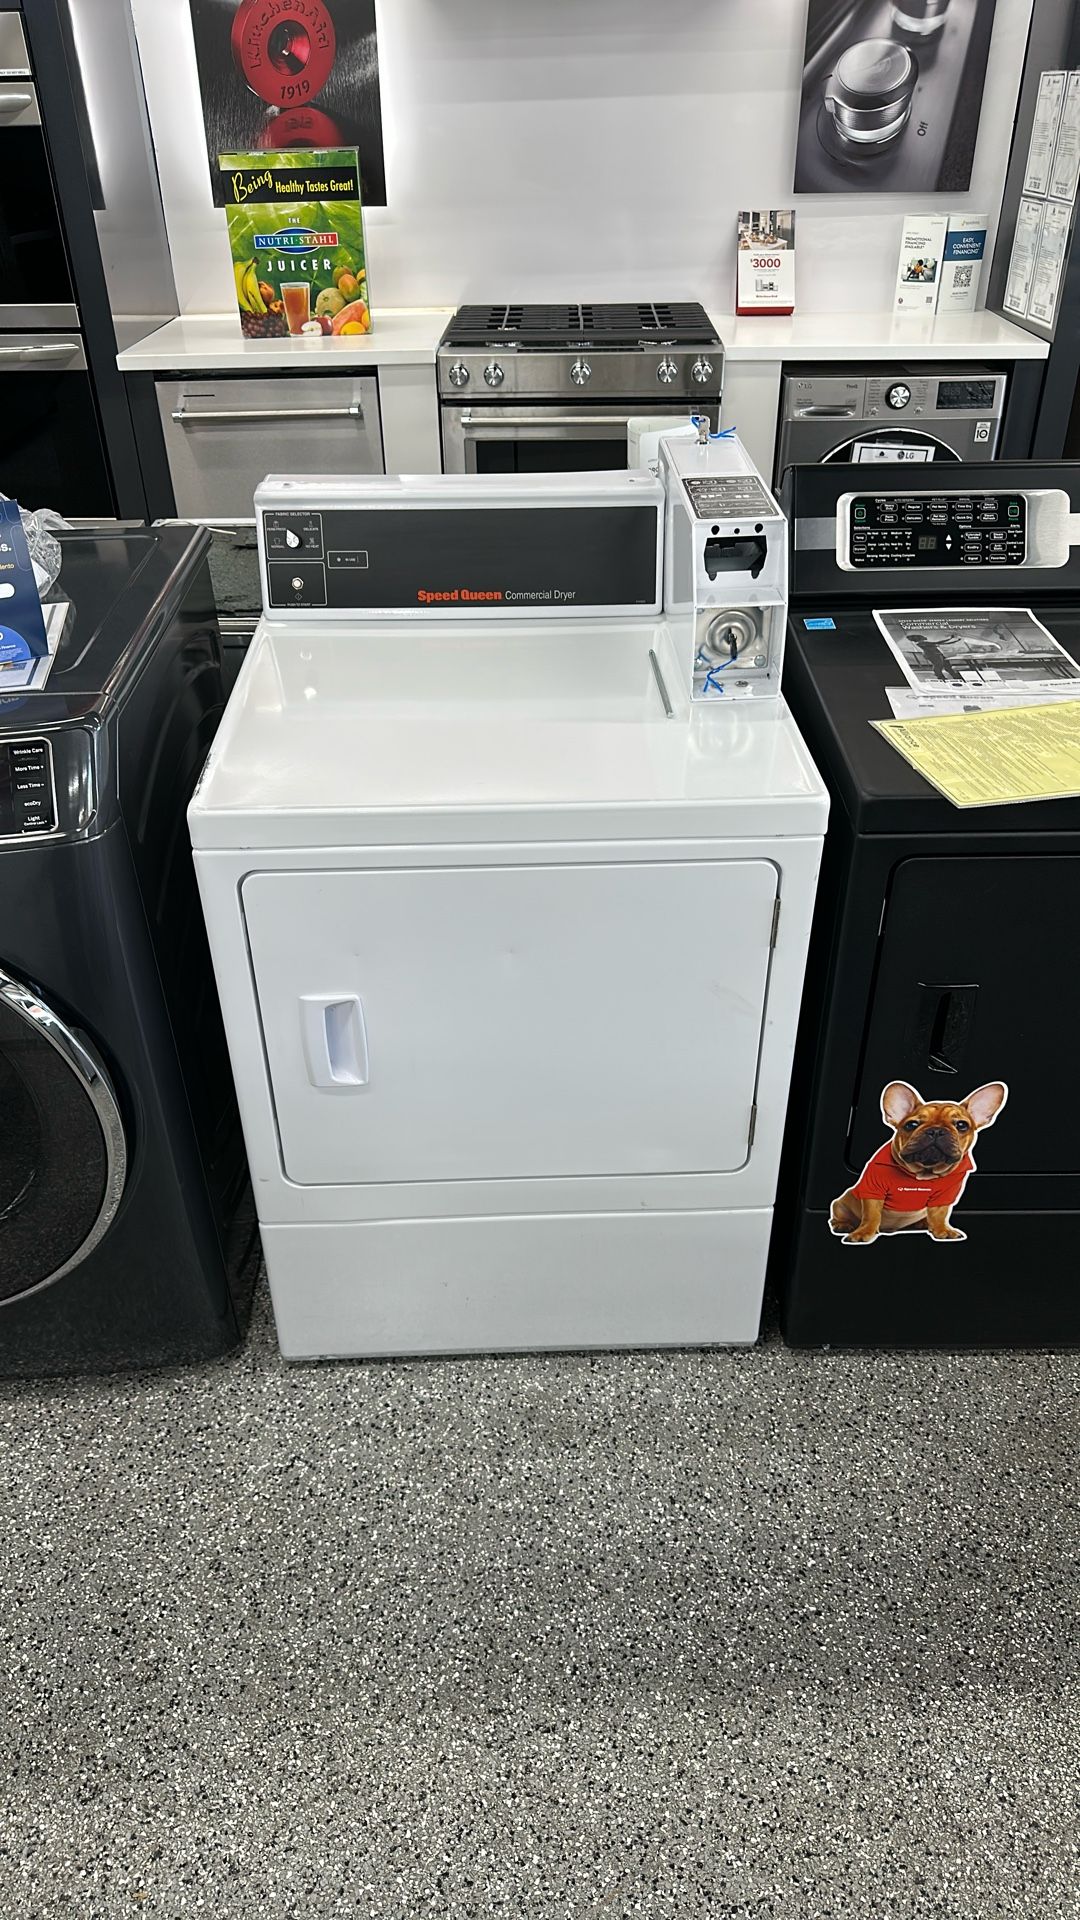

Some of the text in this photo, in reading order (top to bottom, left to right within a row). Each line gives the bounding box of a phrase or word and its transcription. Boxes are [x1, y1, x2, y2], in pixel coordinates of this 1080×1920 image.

[281, 80, 310, 99] 1919
[917, 121, 929, 137] Off
[231, 170, 354, 203] Being Healthy Tastes Great!
[267, 259, 332, 272] JUICER
[905, 452, 915, 460] LG
[417, 589, 576, 603] Speed Queen Commercial Dryer
